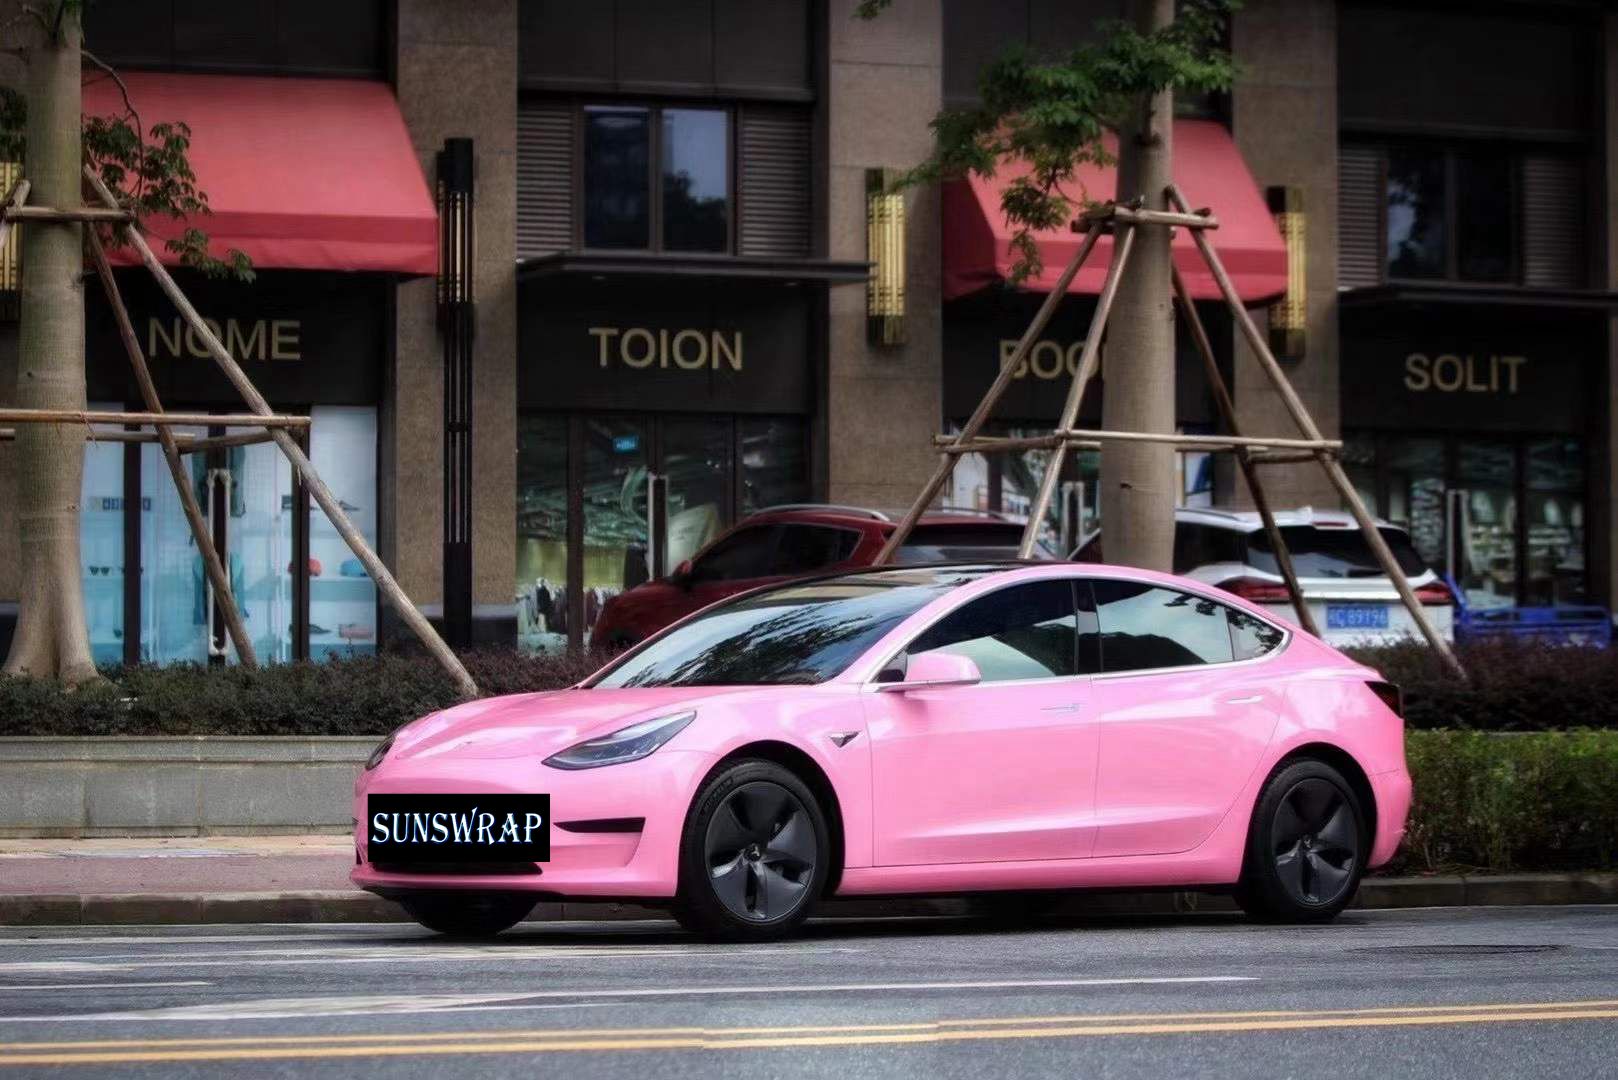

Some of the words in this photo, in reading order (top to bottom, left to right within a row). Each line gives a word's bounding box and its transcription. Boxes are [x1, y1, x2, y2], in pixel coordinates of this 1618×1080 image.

[149, 317, 301, 360] NOME
[588, 327, 743, 371] TOION
[1404, 352, 1527, 394] SOLIT
